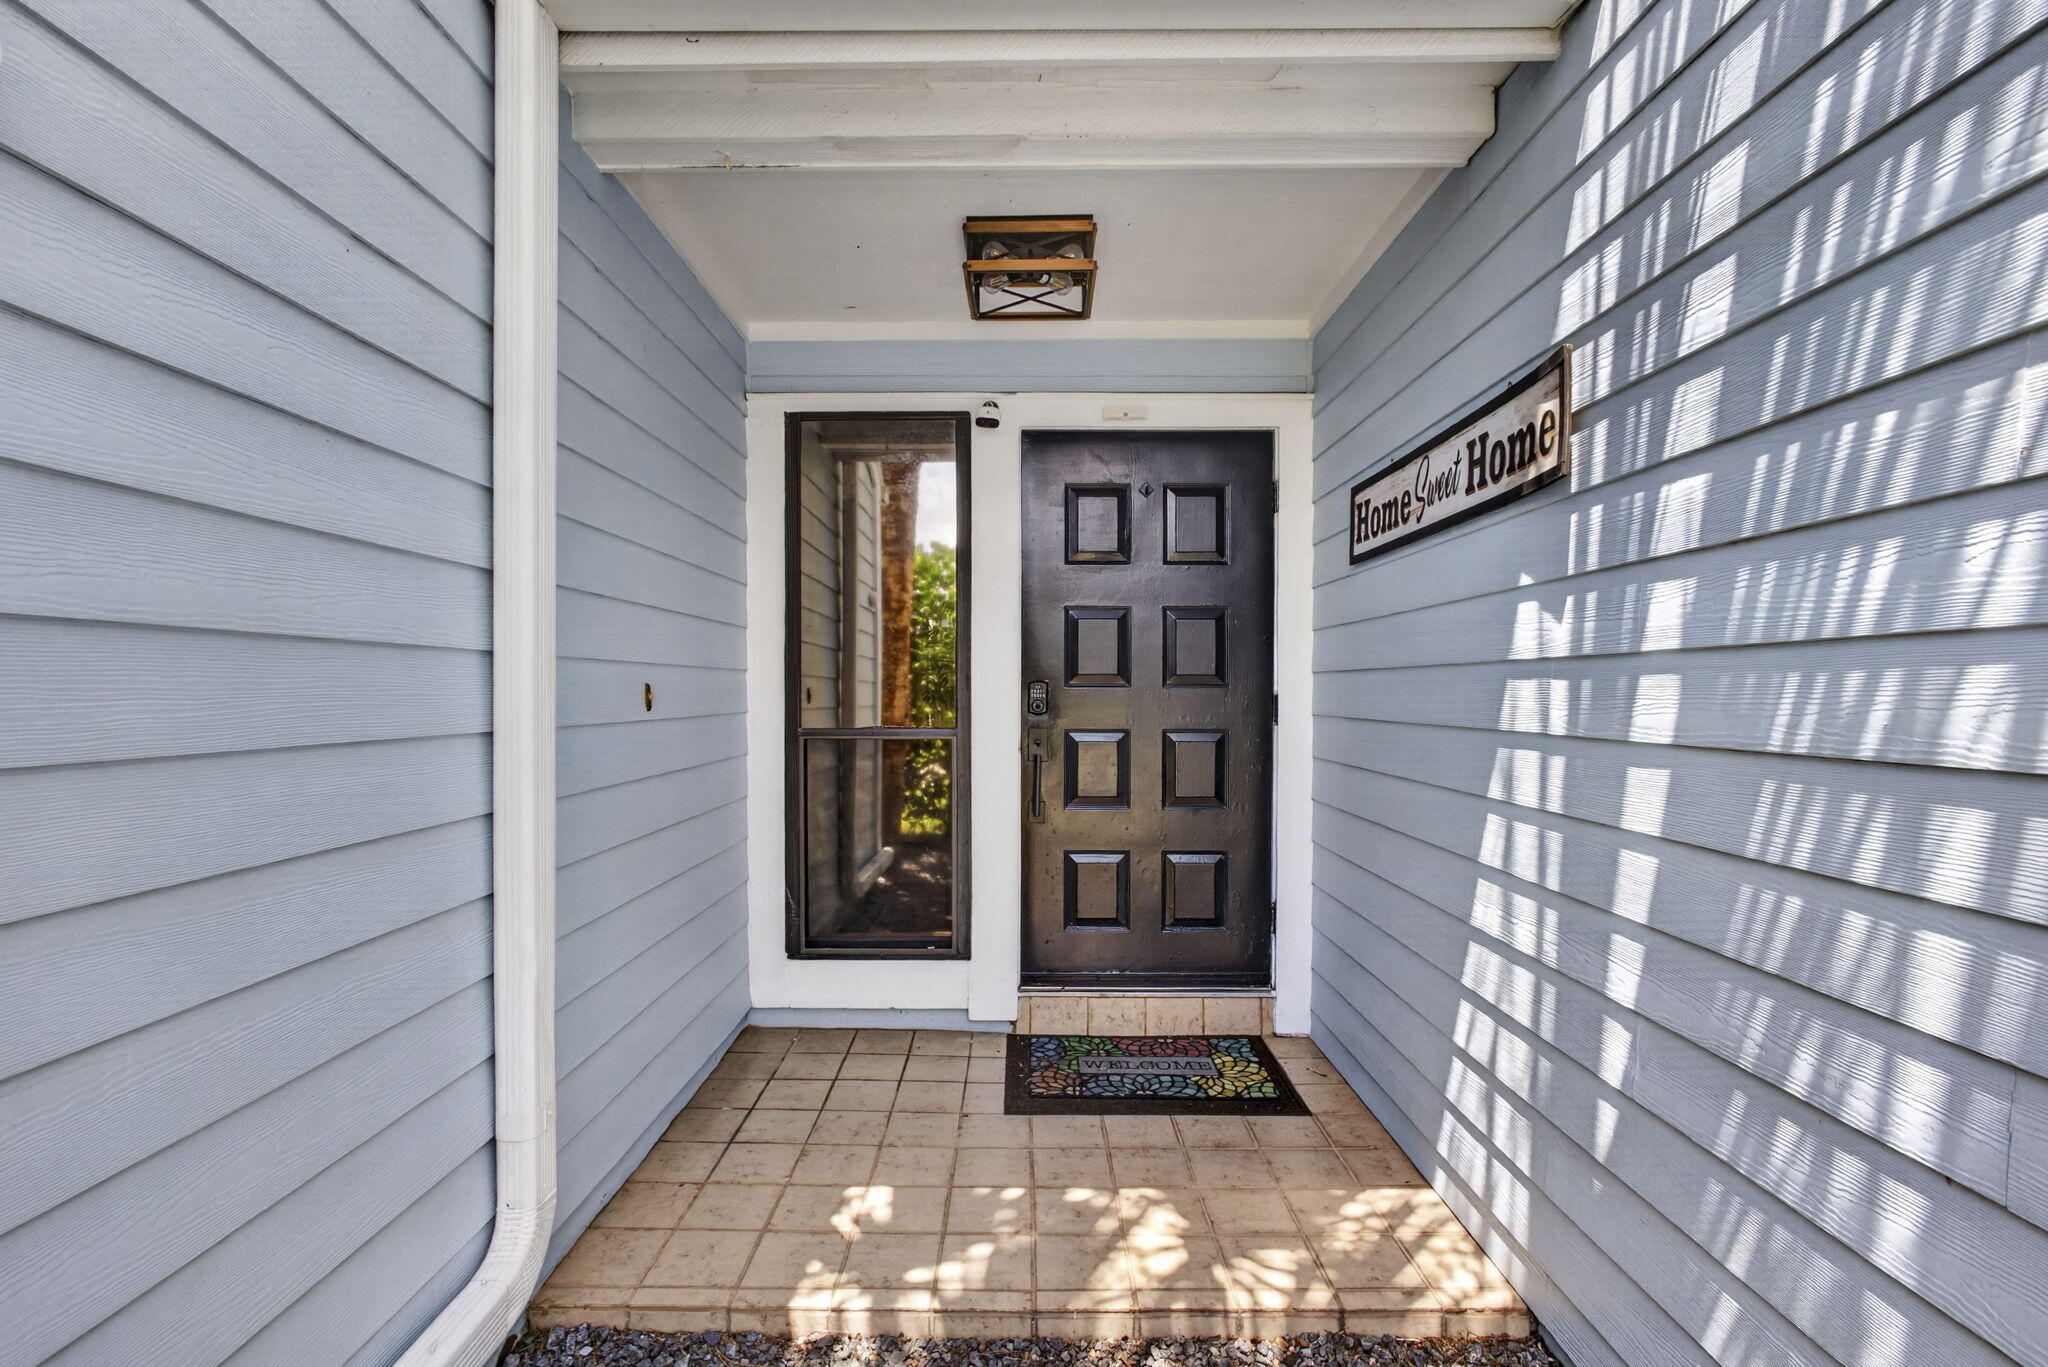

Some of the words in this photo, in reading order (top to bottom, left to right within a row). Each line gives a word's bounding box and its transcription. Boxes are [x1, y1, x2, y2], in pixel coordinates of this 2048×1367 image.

[1355, 490, 1411, 544] Home
[1415, 449, 1462, 523] Sweet
[1465, 409, 1556, 496] Home
[1084, 1060, 1213, 1071] WELCOME
